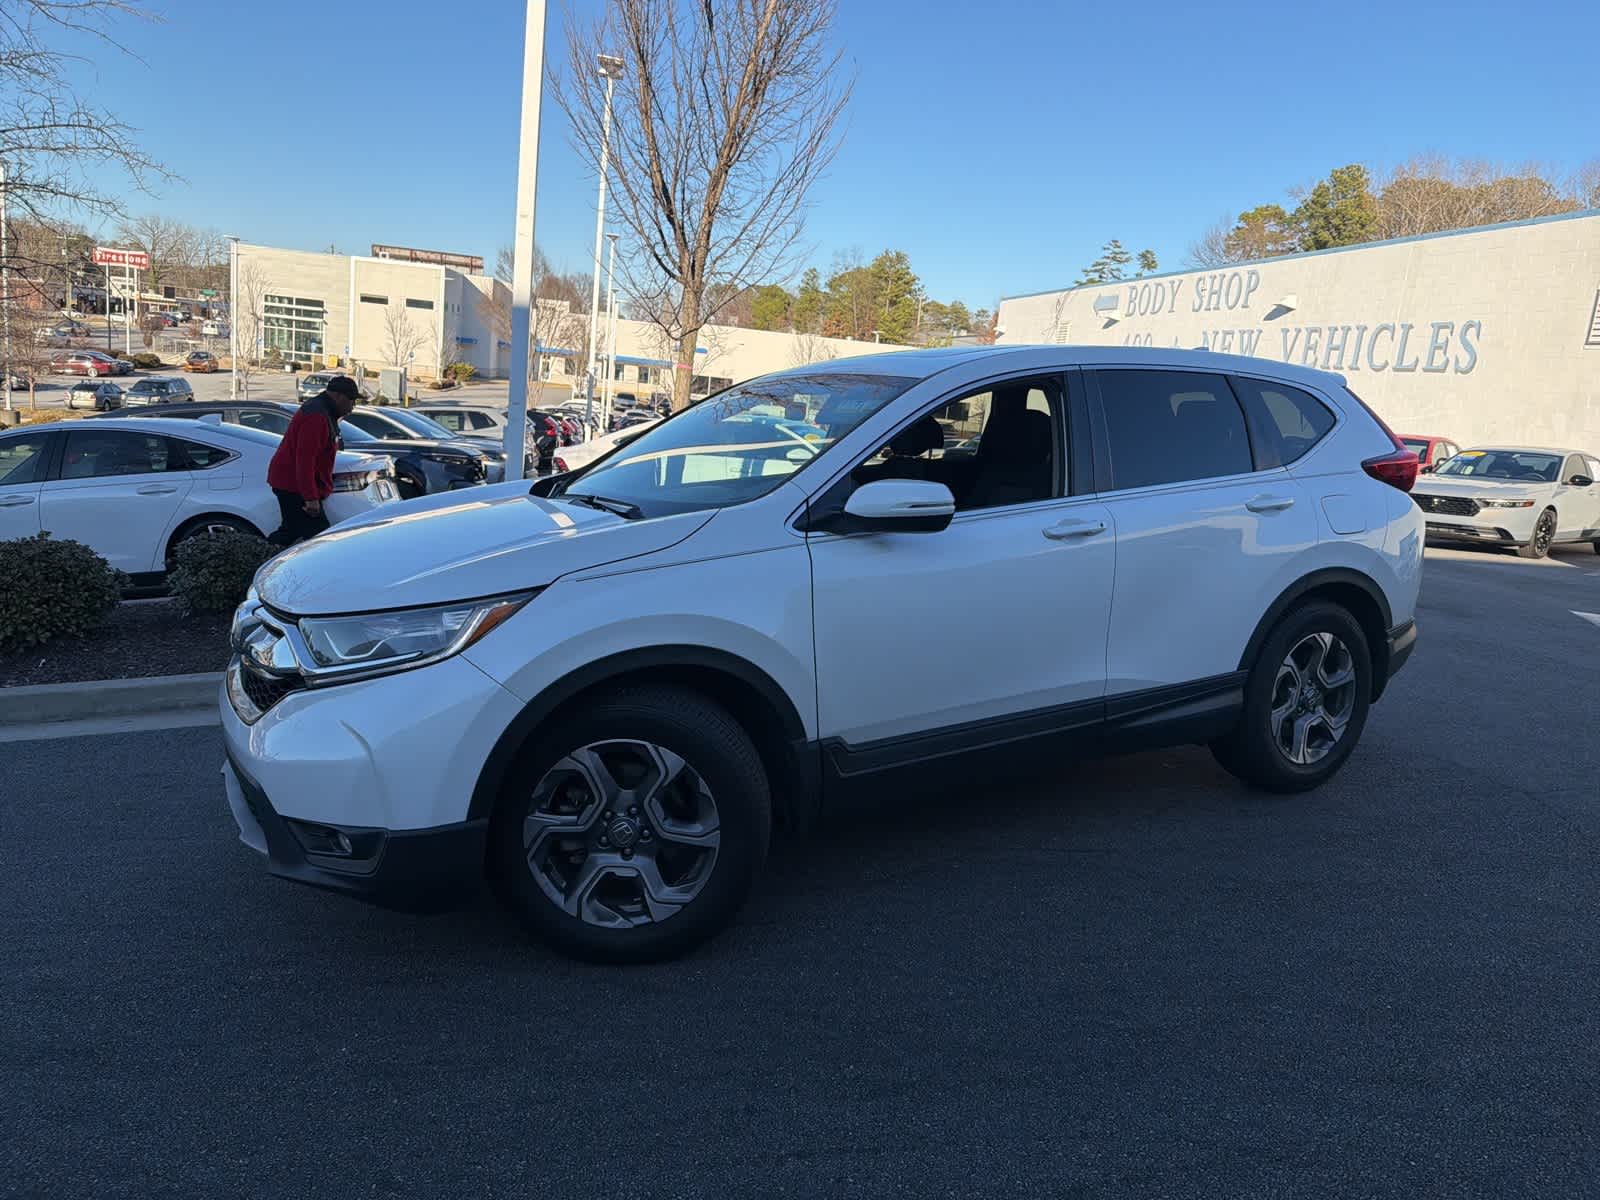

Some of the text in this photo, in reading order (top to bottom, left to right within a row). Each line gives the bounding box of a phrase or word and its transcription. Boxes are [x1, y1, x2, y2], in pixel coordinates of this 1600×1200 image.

[1125, 269, 1261, 317] BODY SHOP
[1280, 320, 1481, 374] VEHICLES
